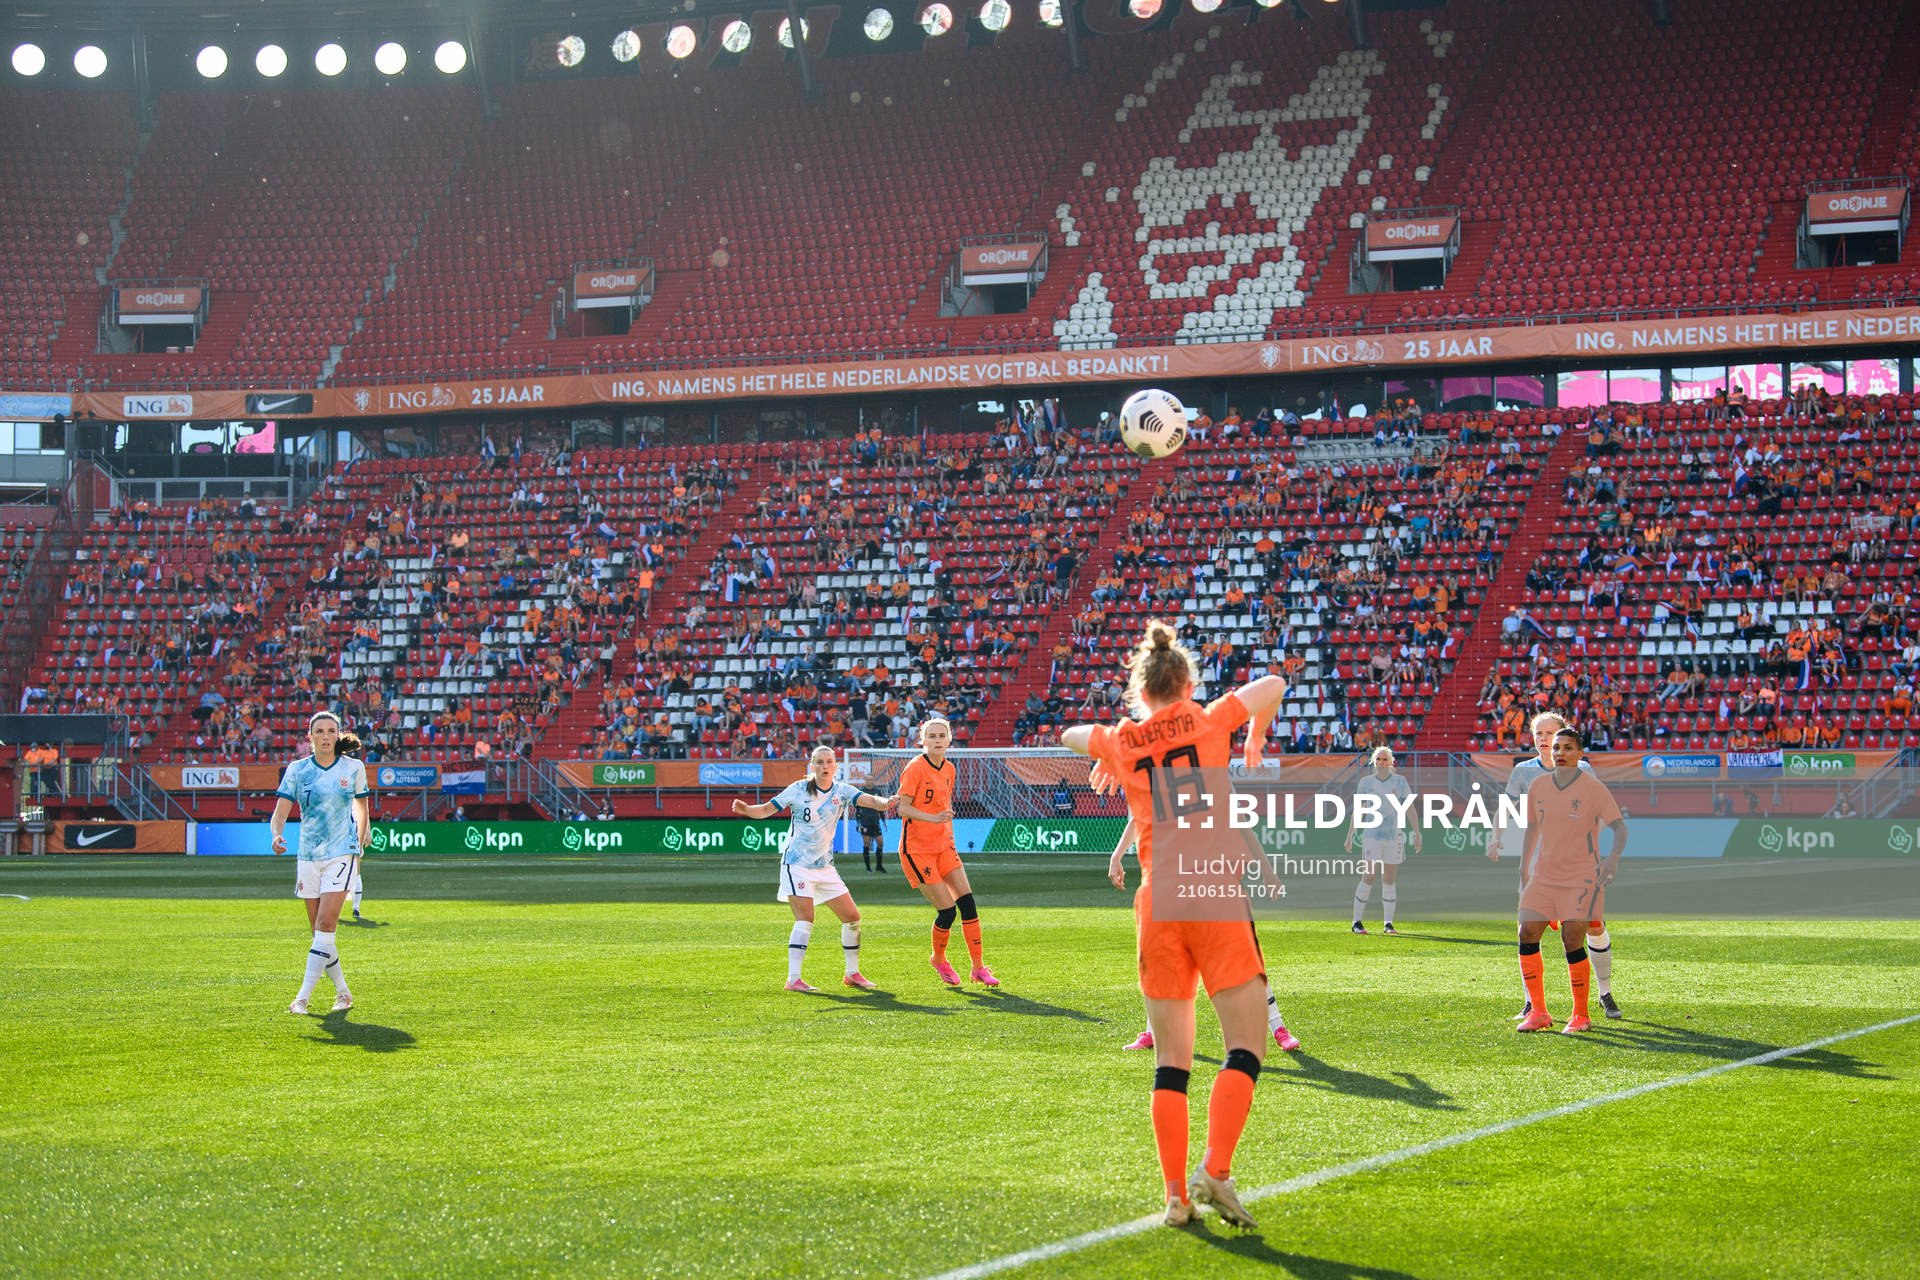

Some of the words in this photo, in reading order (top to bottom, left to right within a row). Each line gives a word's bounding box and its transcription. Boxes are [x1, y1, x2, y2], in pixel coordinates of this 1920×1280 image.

[1576, 331, 1623, 350] ING,
[1632, 325, 1728, 347] NAMENS
[1735, 323, 1779, 343] HET
[1782, 319, 1839, 340] HELE
[1301, 343, 1349, 365] ING
[1404, 340, 1431, 359] 25
[1437, 336, 1493, 357] JAAR
[612, 380, 651, 398] ING,
[658, 376, 737, 396] NAMENS
[742, 374, 777, 391] HET
[781, 371, 827, 390] HELE
[832, 364, 970, 387] NEDERLANDSE
[974, 359, 1062, 382] VOETBAL
[1067, 355, 1170, 376] BEDANKT!
[128, 399, 163, 414] ING
[388, 391, 427, 409] ING
[471, 388, 493, 405] 25
[497, 384, 545, 404] JAAR
[620, 767, 645, 781] kpn
[1666, 759, 1717, 768] NEDERLANDSE
[1810, 757, 1844, 774] kpn
[186, 772, 215, 785] ING
[1134, 744, 1210, 822] 18
[304, 789, 312, 807] 7
[925, 789, 934, 804] 9
[803, 807, 811, 823] 8
[389, 829, 426, 851] kpn
[486, 828, 523, 850] kpn
[584, 828, 623, 851] kpn
[685, 828, 724, 851] kpn
[765, 828, 790, 853] kp
[1036, 826, 1078, 850] kpn
[1261, 824, 1306, 850] kpn
[1786, 827, 1835, 852] kpn
[337, 862, 347, 879] 7
